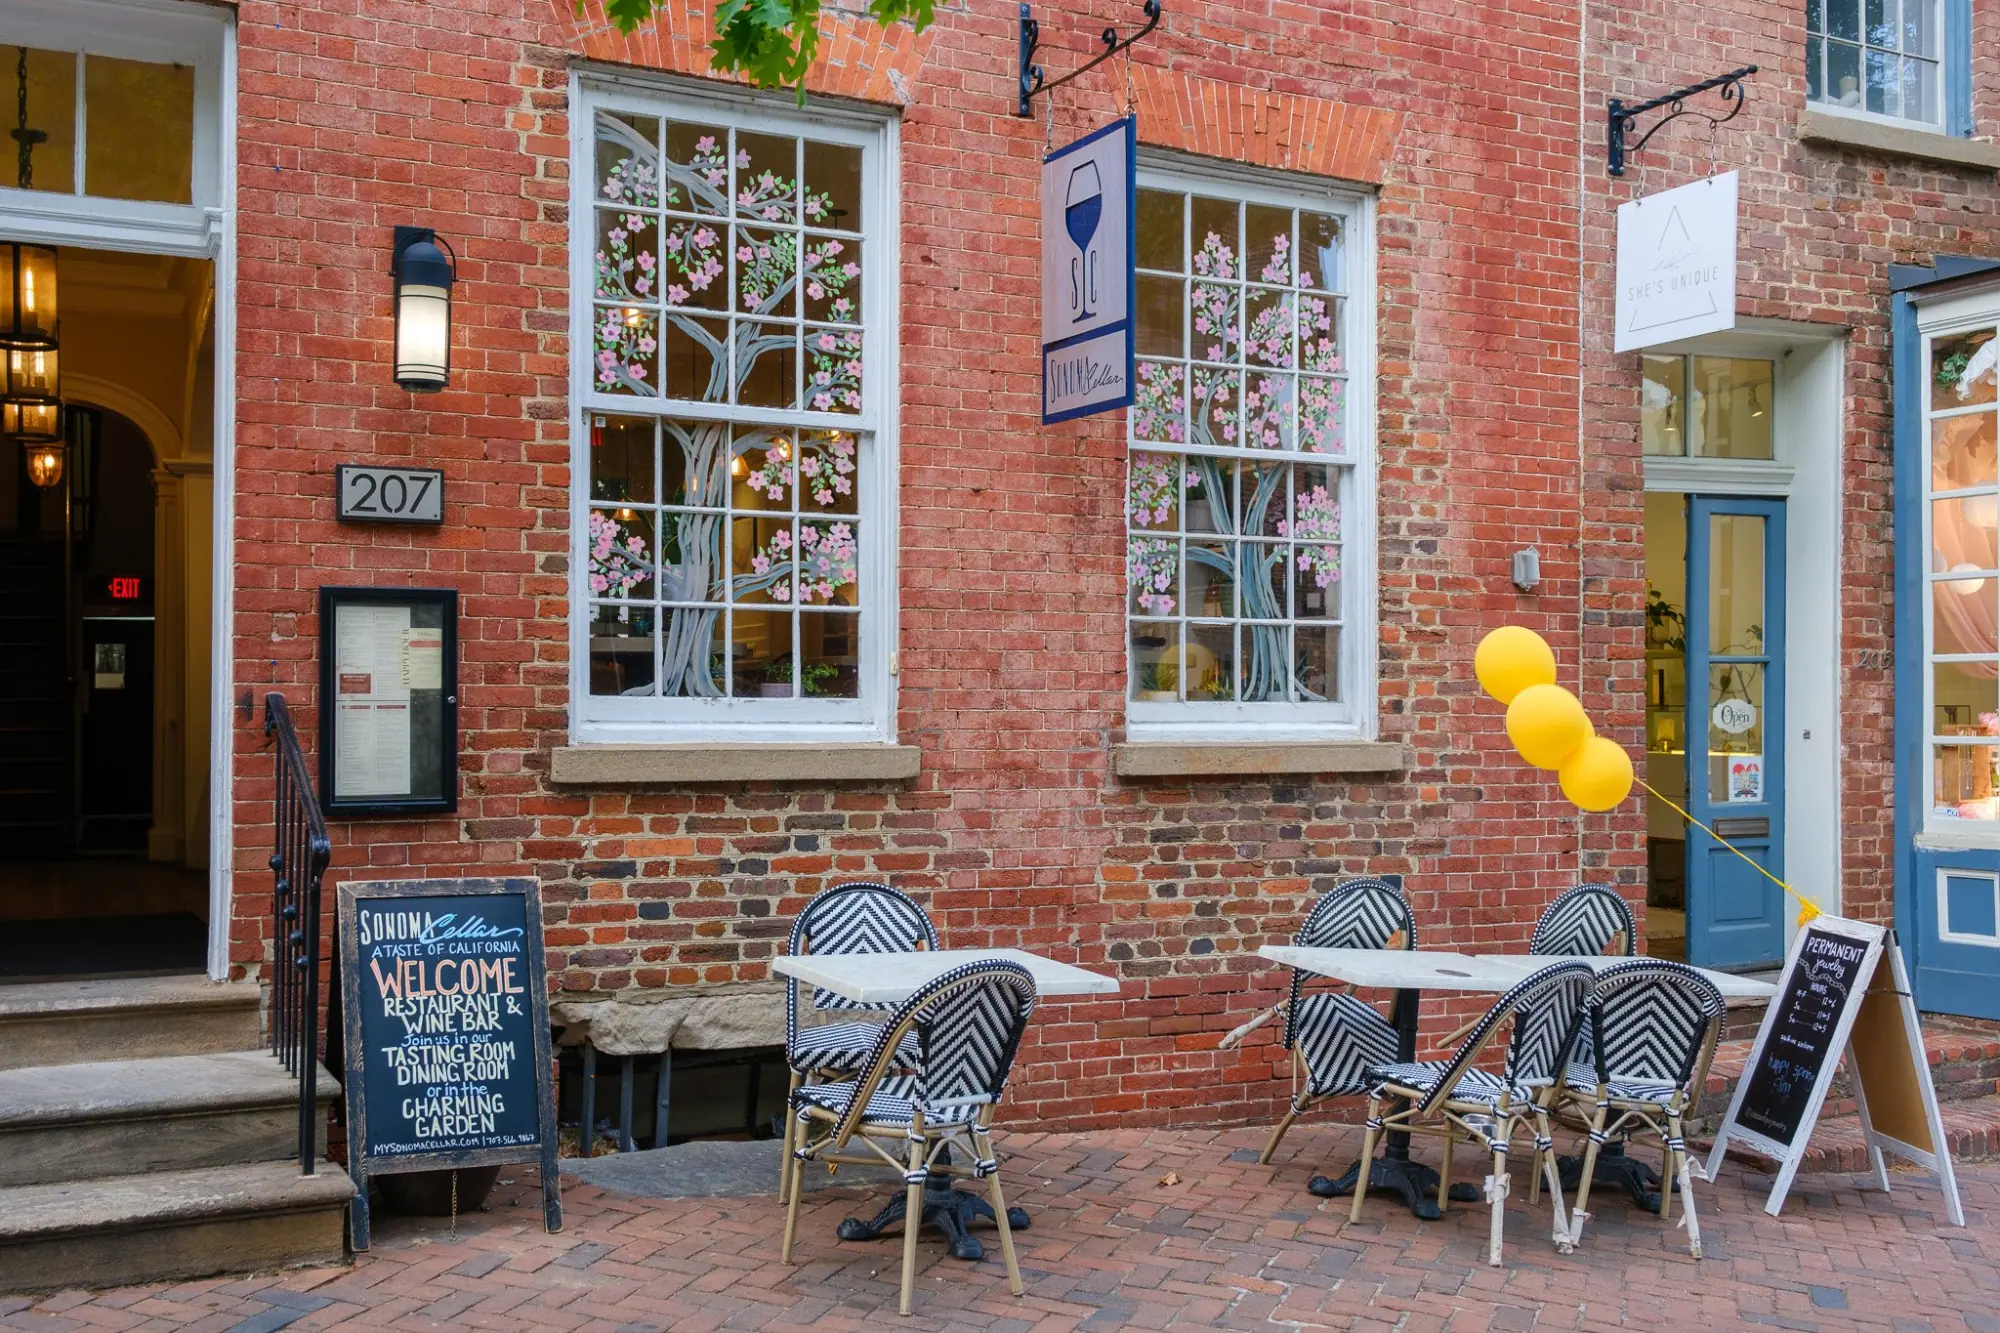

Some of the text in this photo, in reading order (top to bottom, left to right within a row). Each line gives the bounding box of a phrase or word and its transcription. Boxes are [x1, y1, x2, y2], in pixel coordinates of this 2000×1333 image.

[1628, 265, 1718, 301] SHE'S UNIQUE
[1050, 356, 1123, 404] SONOMA Cellar
[350, 473, 434, 514] 207
[112, 577, 140, 598] EXIT
[1721, 705, 1750, 728] Open
[360, 909, 524, 946] SONOMA Cellar
[371, 940, 521, 958] A TASTE OF CALIFORNIA
[1806, 936, 1865, 964] PERMANENT
[369, 956, 524, 999] WELCOME
[1811, 955, 1846, 979] jewelry
[1810, 982, 1828, 995] HOURS
[384, 993, 523, 1017] RESTAURANT &
[401, 1011, 503, 1034] WINE BAR
[401, 1032, 492, 1047] Join us in our
[381, 1040, 516, 1067] TASTING ROOM
[397, 1060, 510, 1086] DINING ROOM
[426, 1081, 488, 1098] or in the
[402, 1093, 505, 1119] CHARMING
[415, 1113, 495, 1138] GARDEN
[373, 1137, 479, 1156] MYSONOMACELLAR.COM
